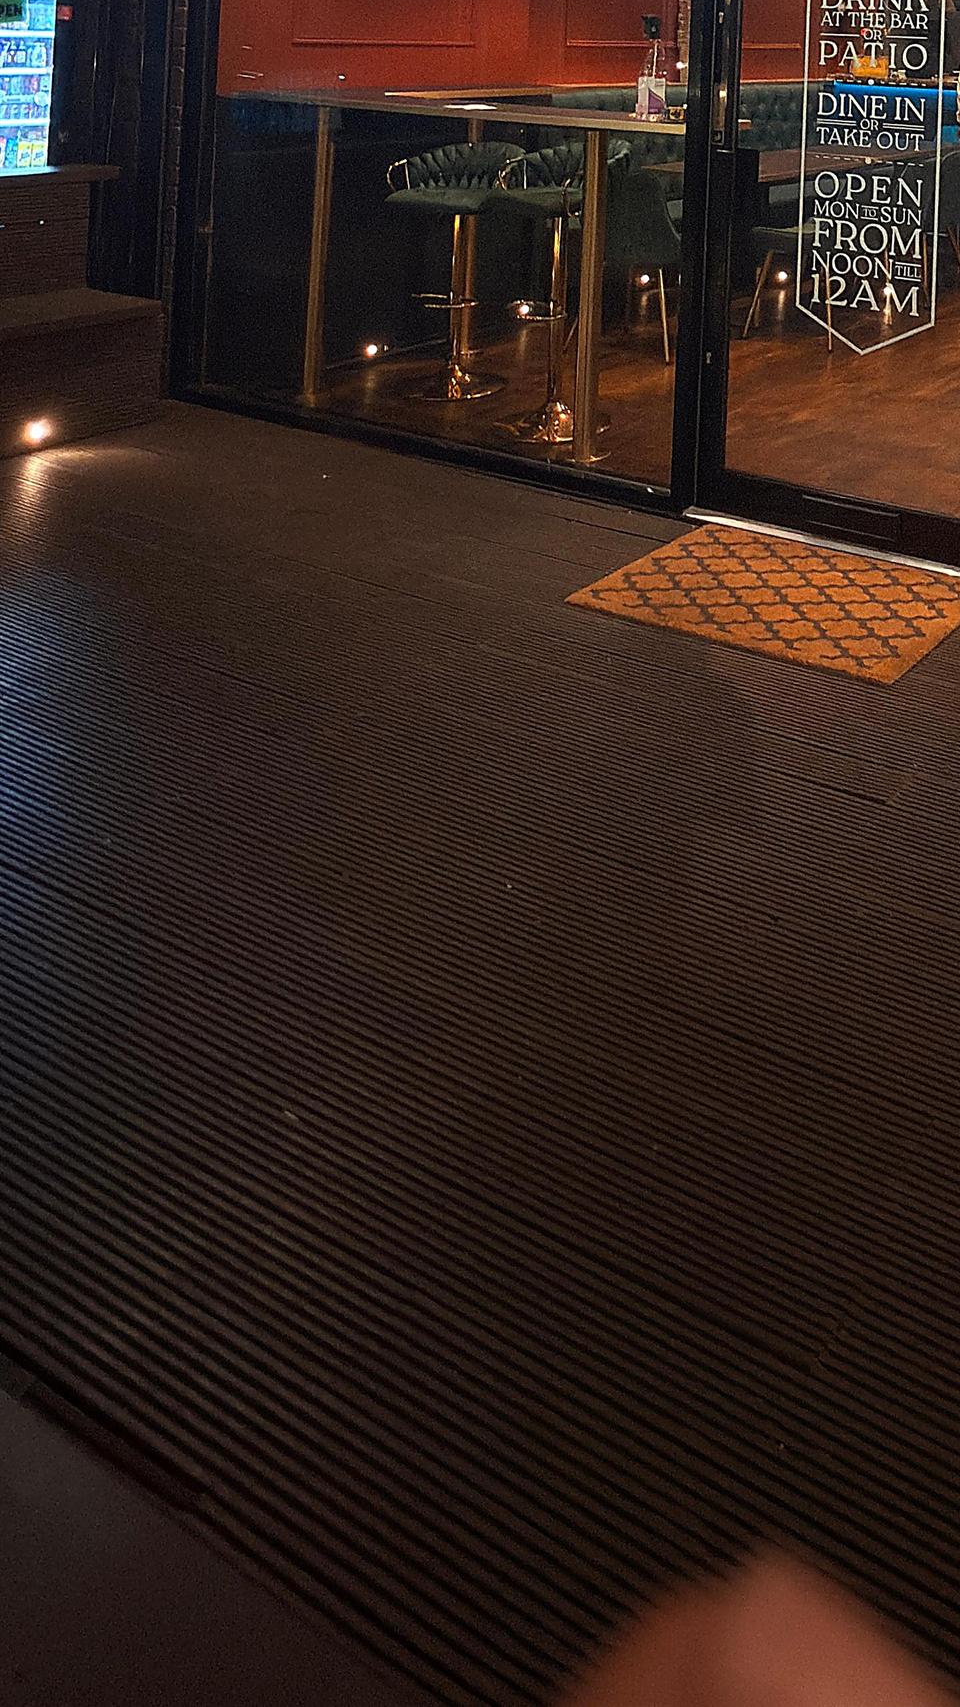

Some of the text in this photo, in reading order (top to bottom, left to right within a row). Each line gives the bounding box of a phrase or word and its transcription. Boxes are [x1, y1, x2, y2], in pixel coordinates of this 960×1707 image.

[820, 11, 928, 29] AT THE BAR
[864, 29, 882, 40] OR
[818, 40, 928, 70] PATIO
[816, 92, 926, 122] DINE IN
[816, 127, 925, 152] TAKE OUT
[860, 119, 879, 131] OR
[814, 171, 923, 207] OPEN
[814, 199, 922, 226] MON TO SUN
[812, 217, 922, 259] FROM
[811, 249, 922, 281] NOON TILL
[811, 273, 920, 317] 12AM
